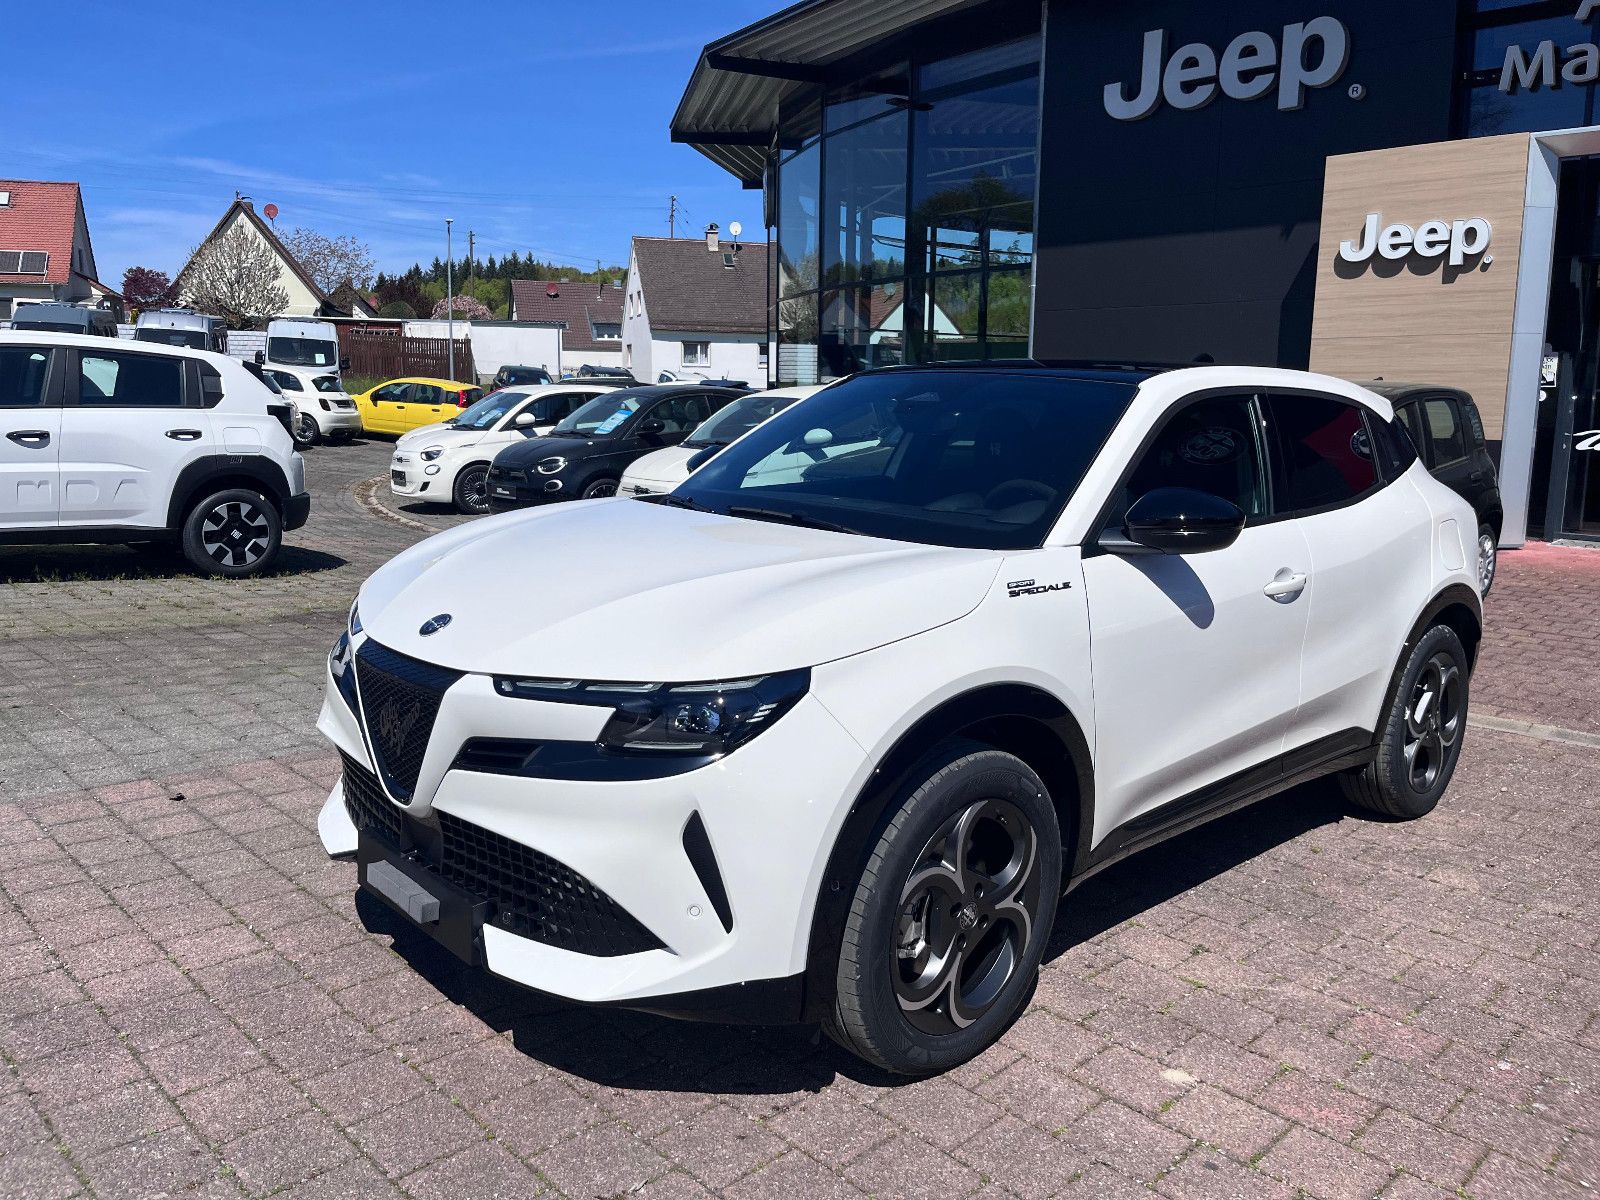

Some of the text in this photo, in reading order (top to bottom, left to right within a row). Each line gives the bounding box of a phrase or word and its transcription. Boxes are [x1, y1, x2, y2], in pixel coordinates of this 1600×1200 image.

[1103, 16, 1350, 121] Jeep
[1339, 212, 1492, 266] Jeep
[1008, 580, 1035, 588] SPORT
[1008, 581, 1072, 598] SPECIALE
